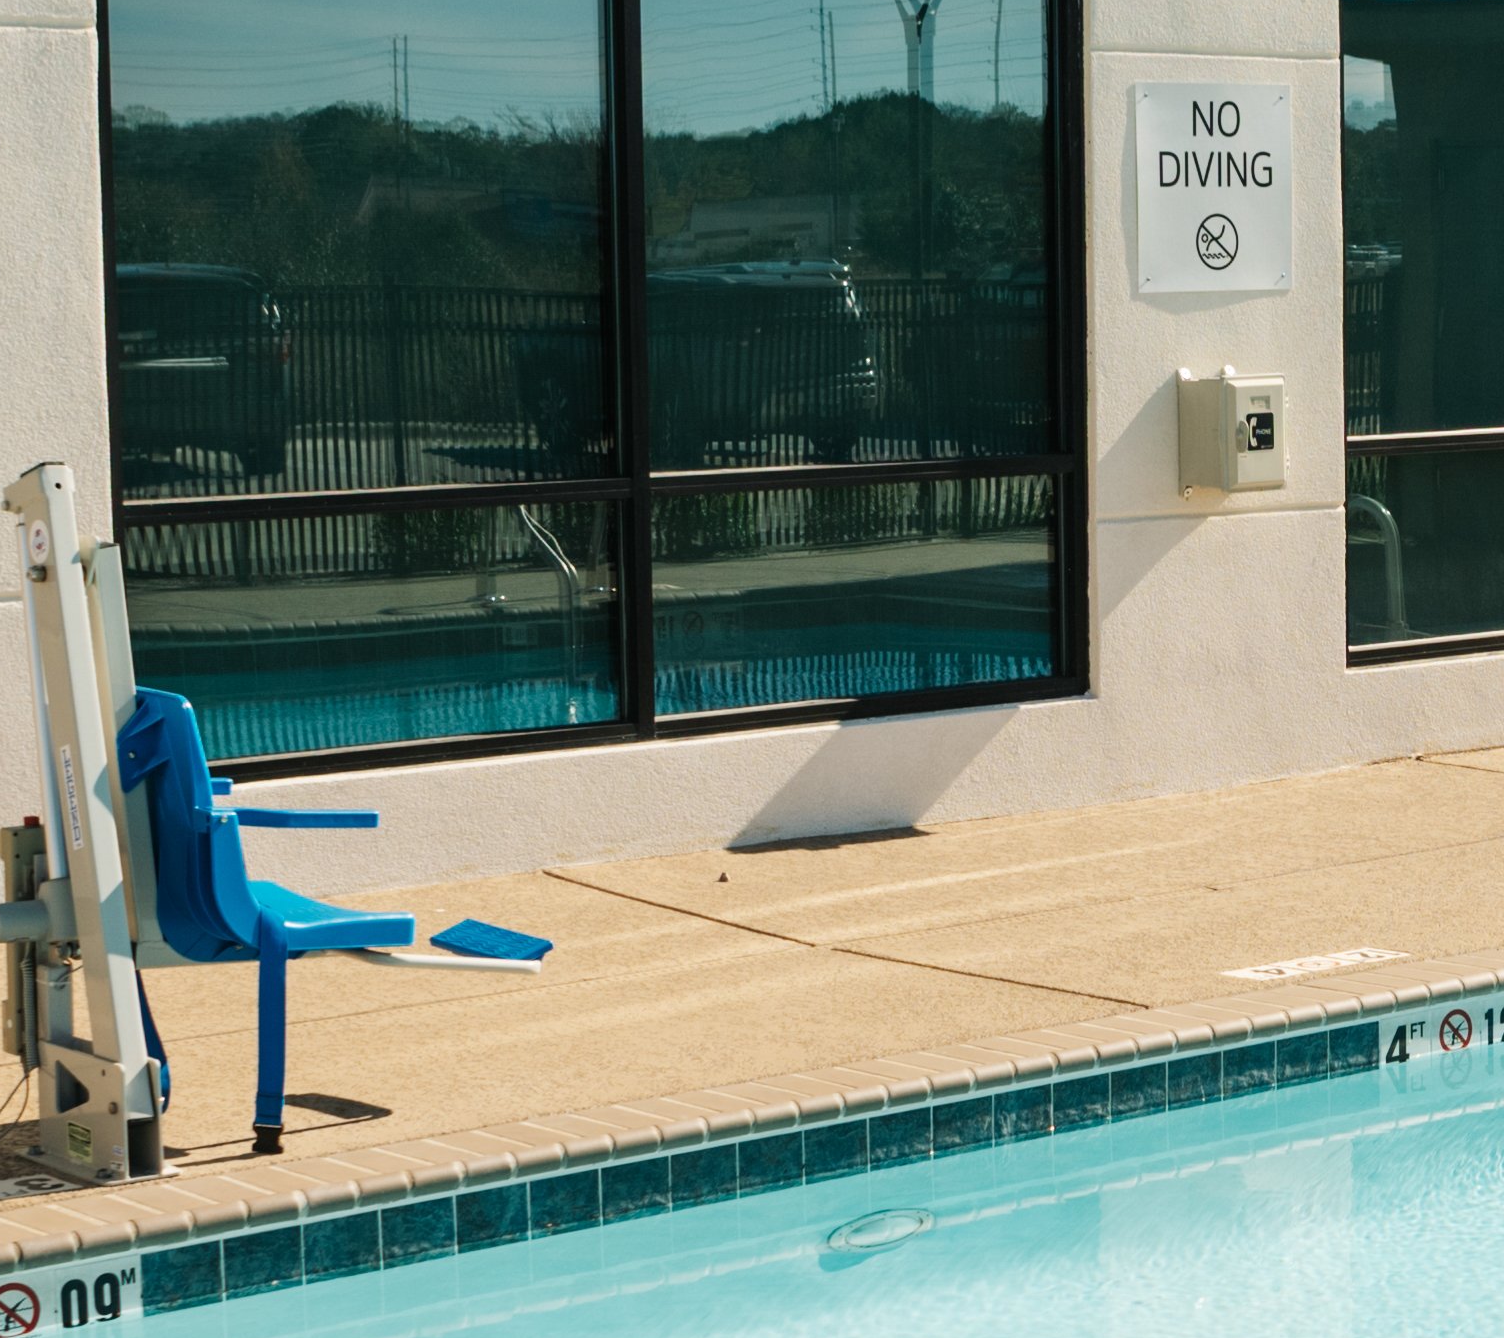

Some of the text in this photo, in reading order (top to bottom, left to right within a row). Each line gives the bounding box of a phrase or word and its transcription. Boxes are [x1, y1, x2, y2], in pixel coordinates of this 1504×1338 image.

[1192, 100, 1241, 138] NO
[1158, 150, 1273, 188] DIVING
[1385, 1020, 1426, 1064] 4 FT
[120, 1266, 137, 1286] M
